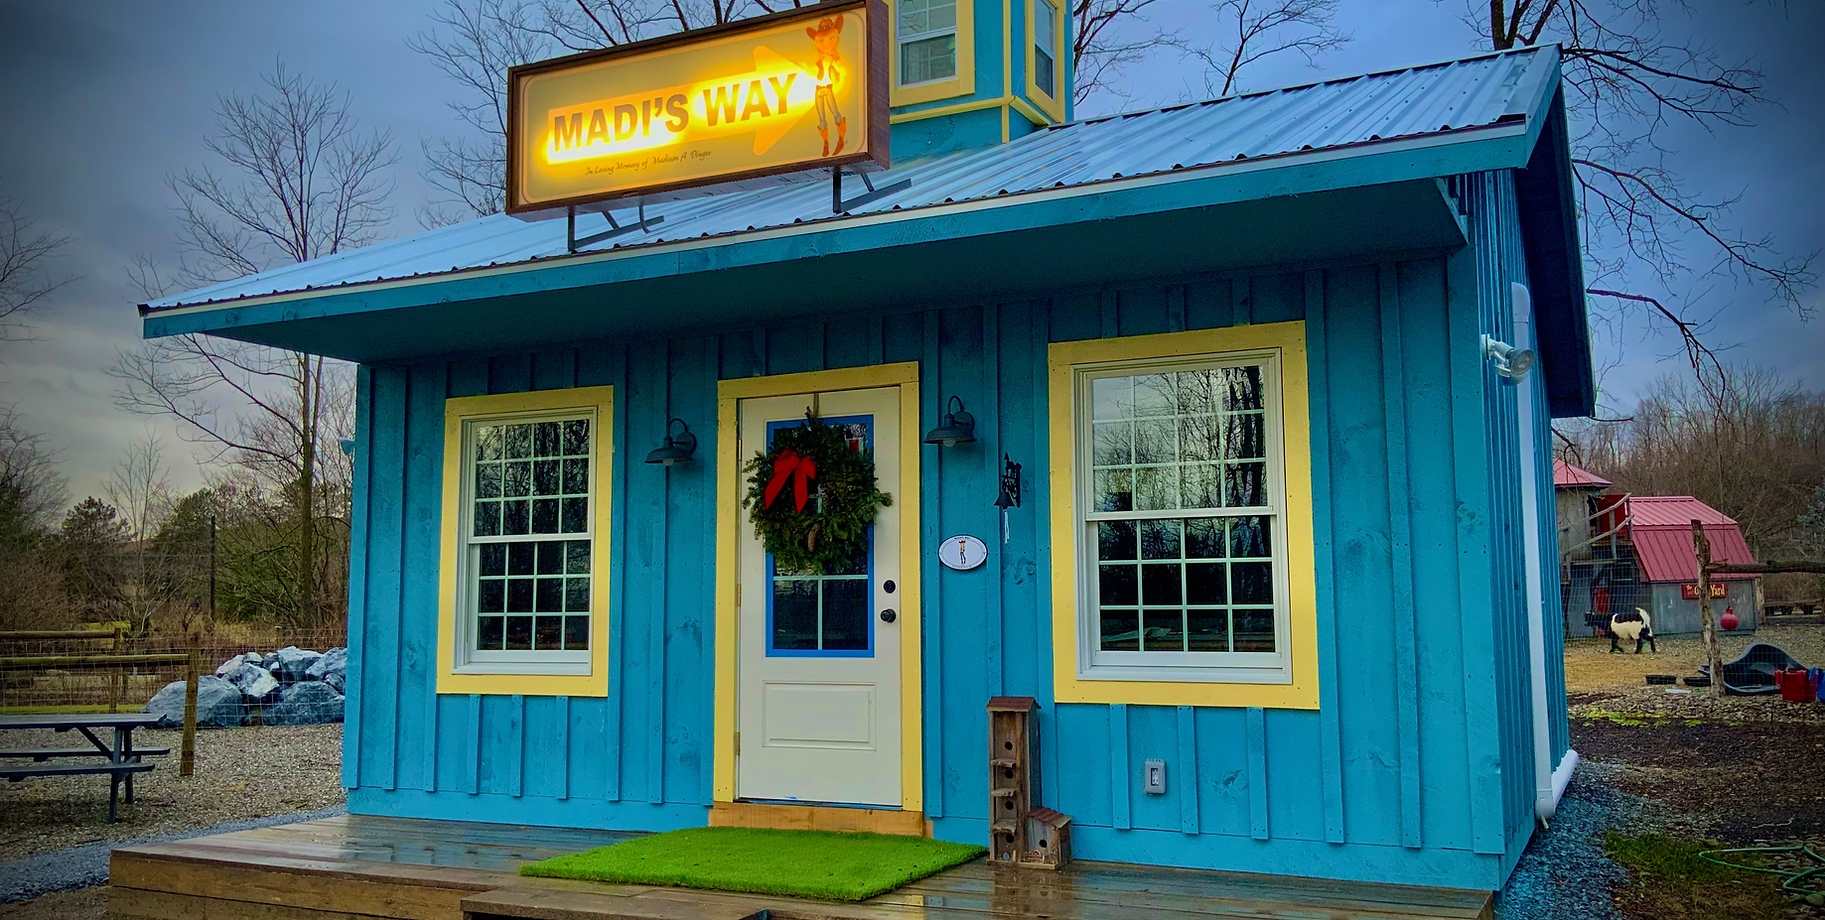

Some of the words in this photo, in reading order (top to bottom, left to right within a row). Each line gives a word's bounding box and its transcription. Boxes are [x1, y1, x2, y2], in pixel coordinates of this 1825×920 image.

[554, 93, 689, 152] MADI'S
[703, 74, 797, 127] WAY
[585, 167, 594, 175] In
[595, 165, 615, 175] Loving
[615, 161, 640, 171] Memory
[641, 157, 649, 169] of
[652, 154, 679, 165] Madison
[1710, 584, 1725, 596] Yard
